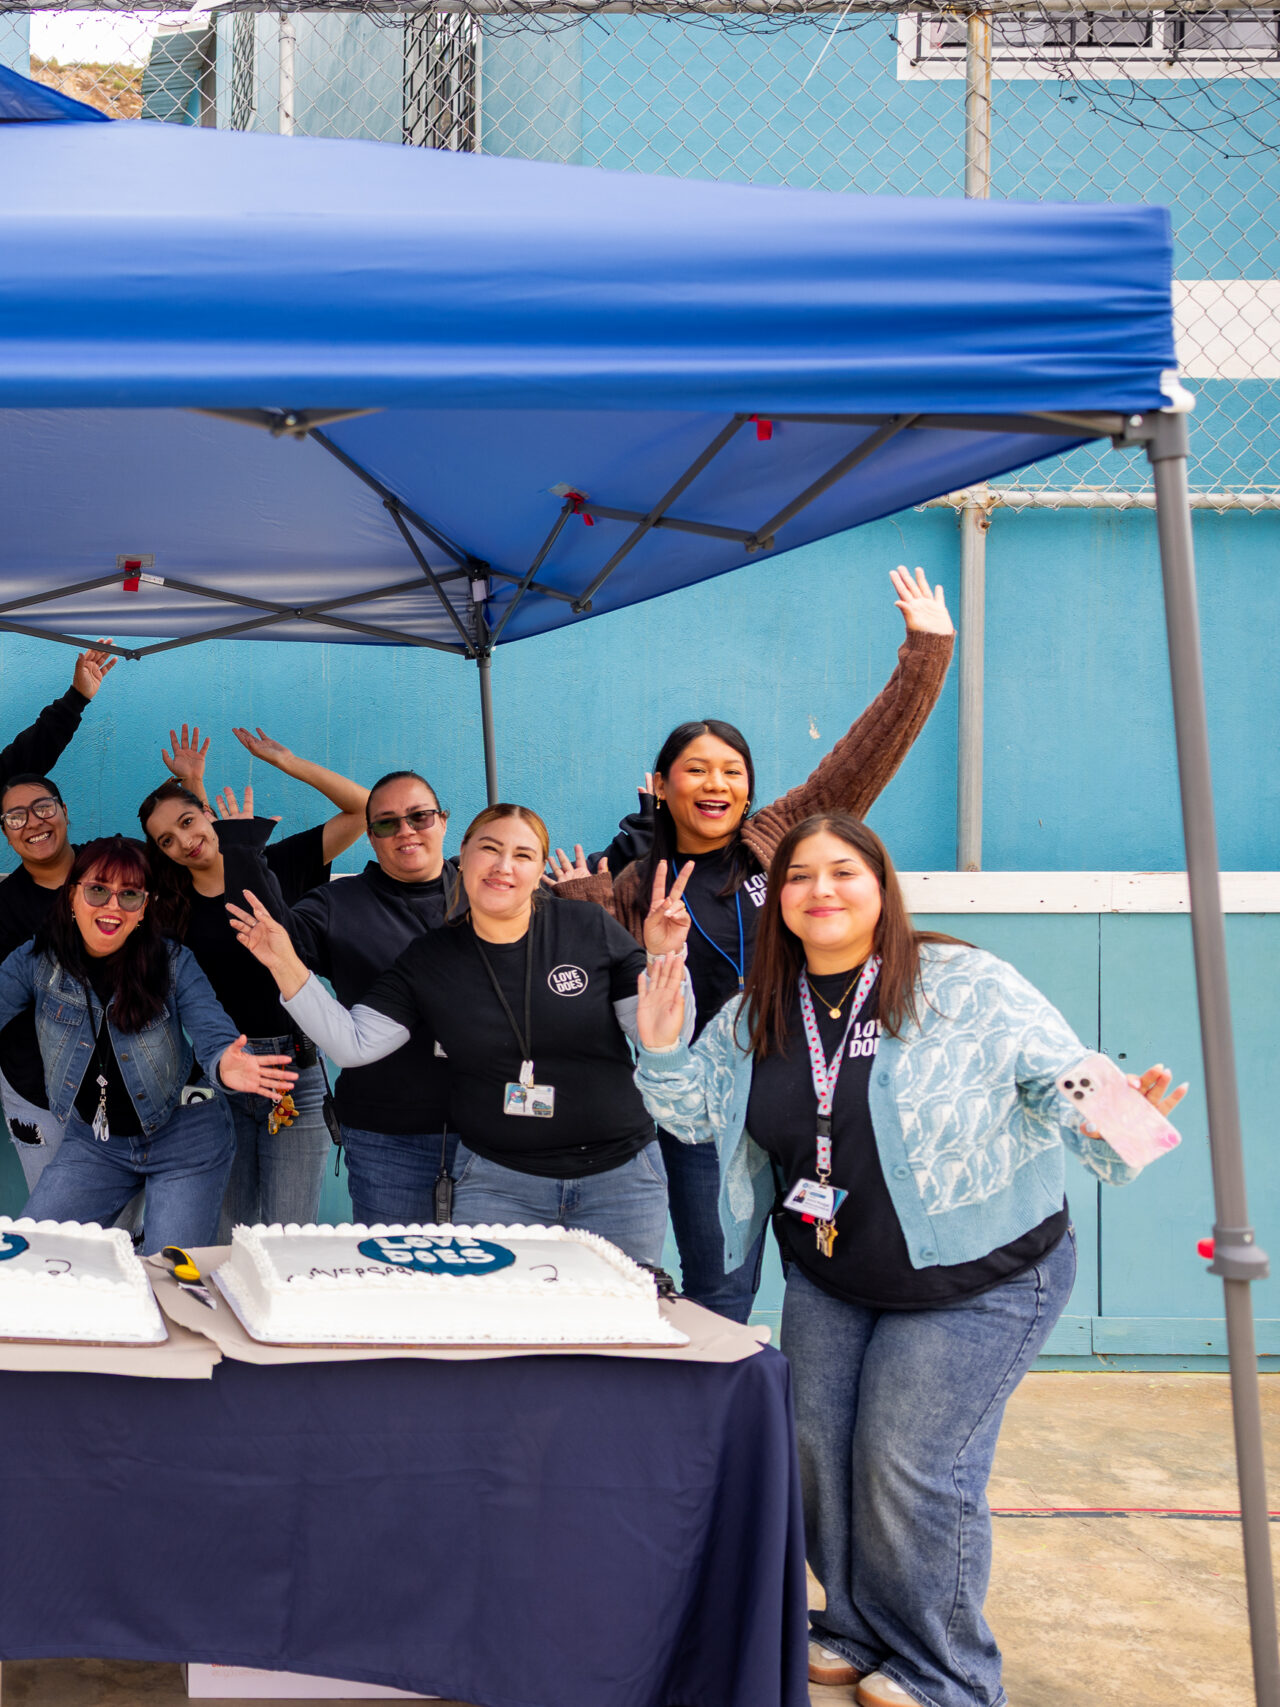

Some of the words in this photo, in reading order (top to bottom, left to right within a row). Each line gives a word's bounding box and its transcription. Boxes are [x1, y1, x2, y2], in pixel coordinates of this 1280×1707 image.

[552, 969, 580, 984] LOVE
[555, 978, 584, 993] DOES
[373, 1236, 481, 1249] LOVE
[380, 1248, 496, 1264] DOES
